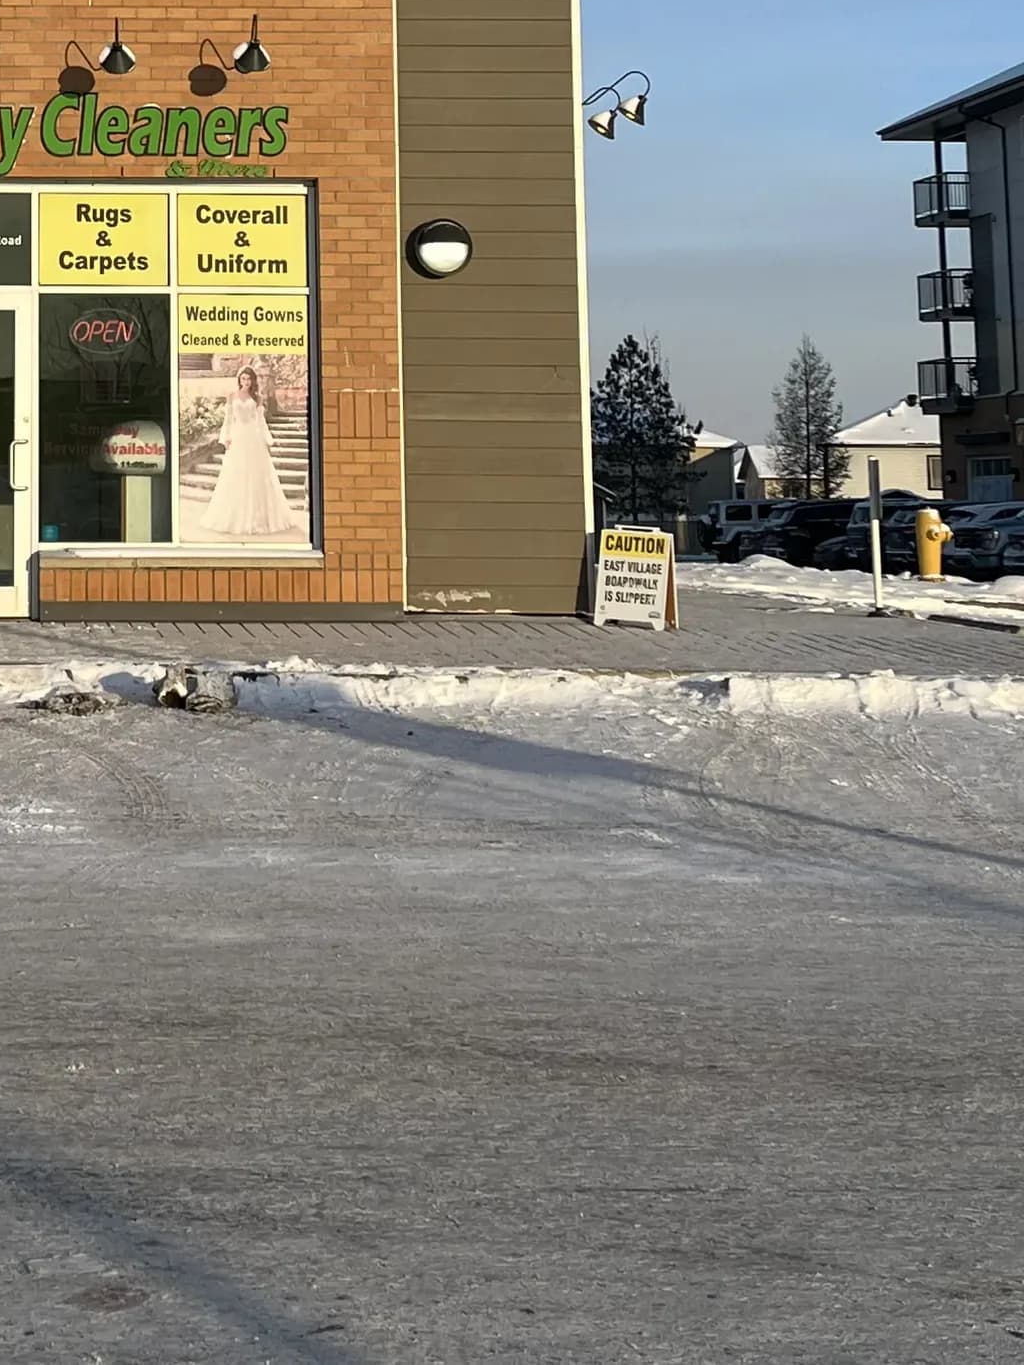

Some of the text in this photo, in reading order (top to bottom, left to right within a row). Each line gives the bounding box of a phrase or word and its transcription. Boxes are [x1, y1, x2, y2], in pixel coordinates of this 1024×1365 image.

[40, 92, 288, 157] Cleaners
[76, 204, 132, 227] Rugs
[195, 205, 288, 224] Coverall
[95, 231, 112, 247] &
[234, 231, 250, 247] &
[58, 251, 149, 274] Carpets
[197, 254, 288, 273] Uniform
[185, 306, 304, 325] Wedding Gowns
[73, 321, 134, 344] OPEN
[181, 333, 304, 347] Cleaned & Preserved
[103, 441, 166, 455] Available
[605, 535, 665, 554] CAUTION
[604, 560, 662, 574] EAST VILLAGE
[604, 591, 613, 602] IS
